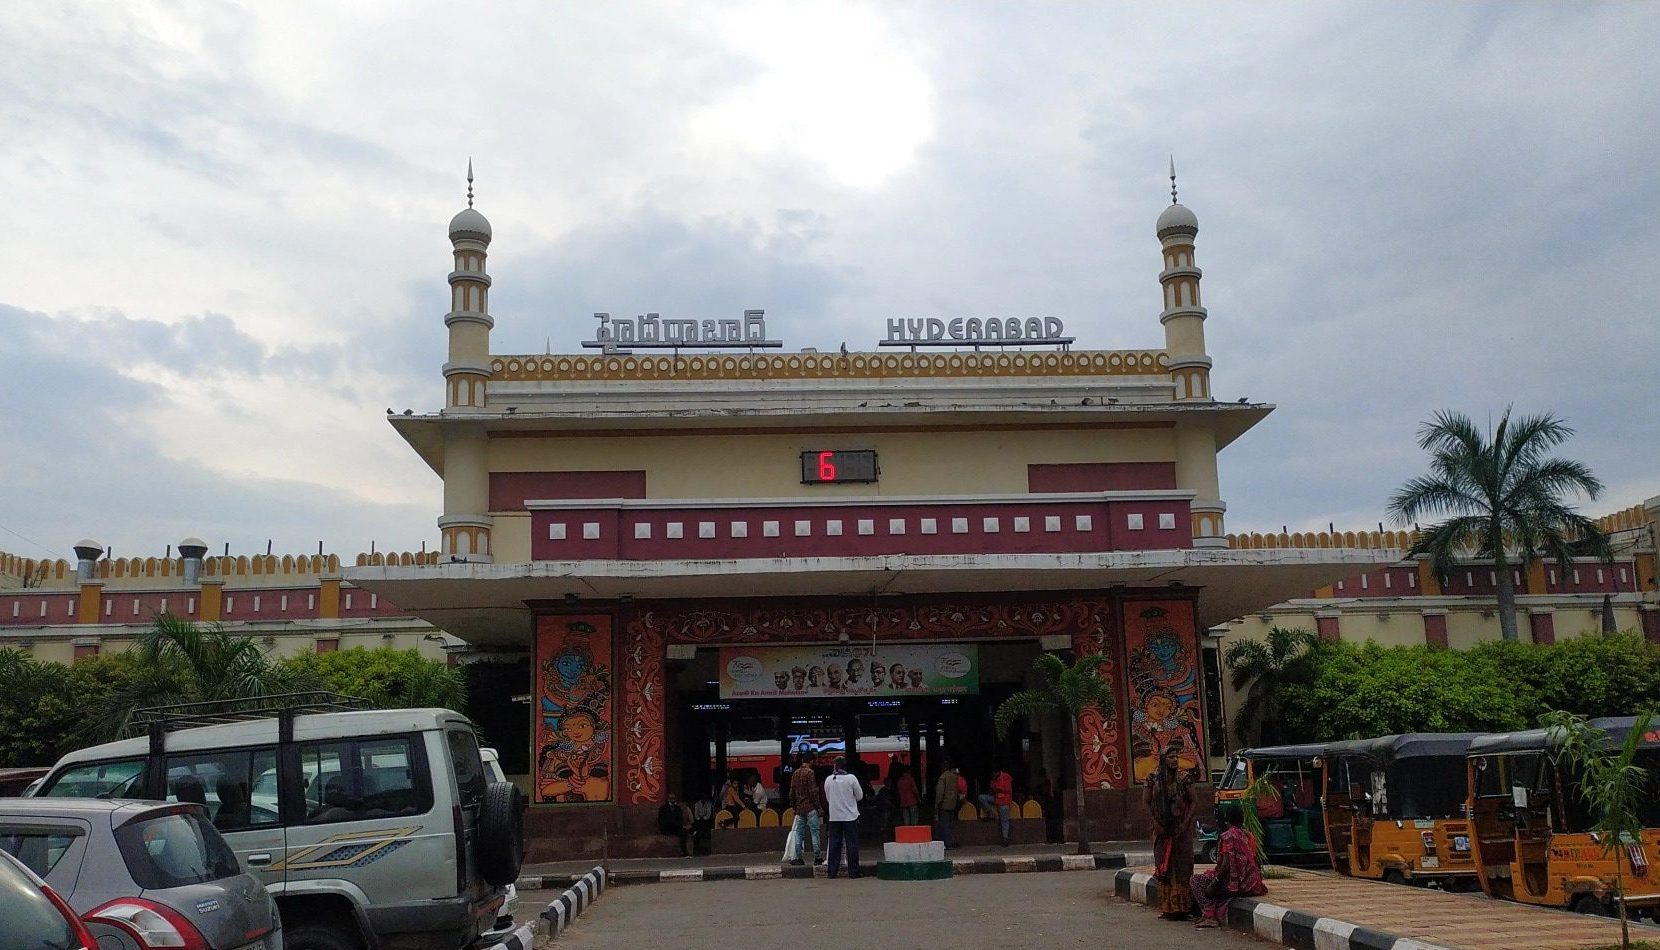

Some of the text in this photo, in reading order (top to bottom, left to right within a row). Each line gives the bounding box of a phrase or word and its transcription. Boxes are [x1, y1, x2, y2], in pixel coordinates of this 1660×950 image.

[887, 316, 1064, 340] HYDERABAD
[819, 452, 835, 480] 6
[198, 904, 220, 914] SUZUKI
